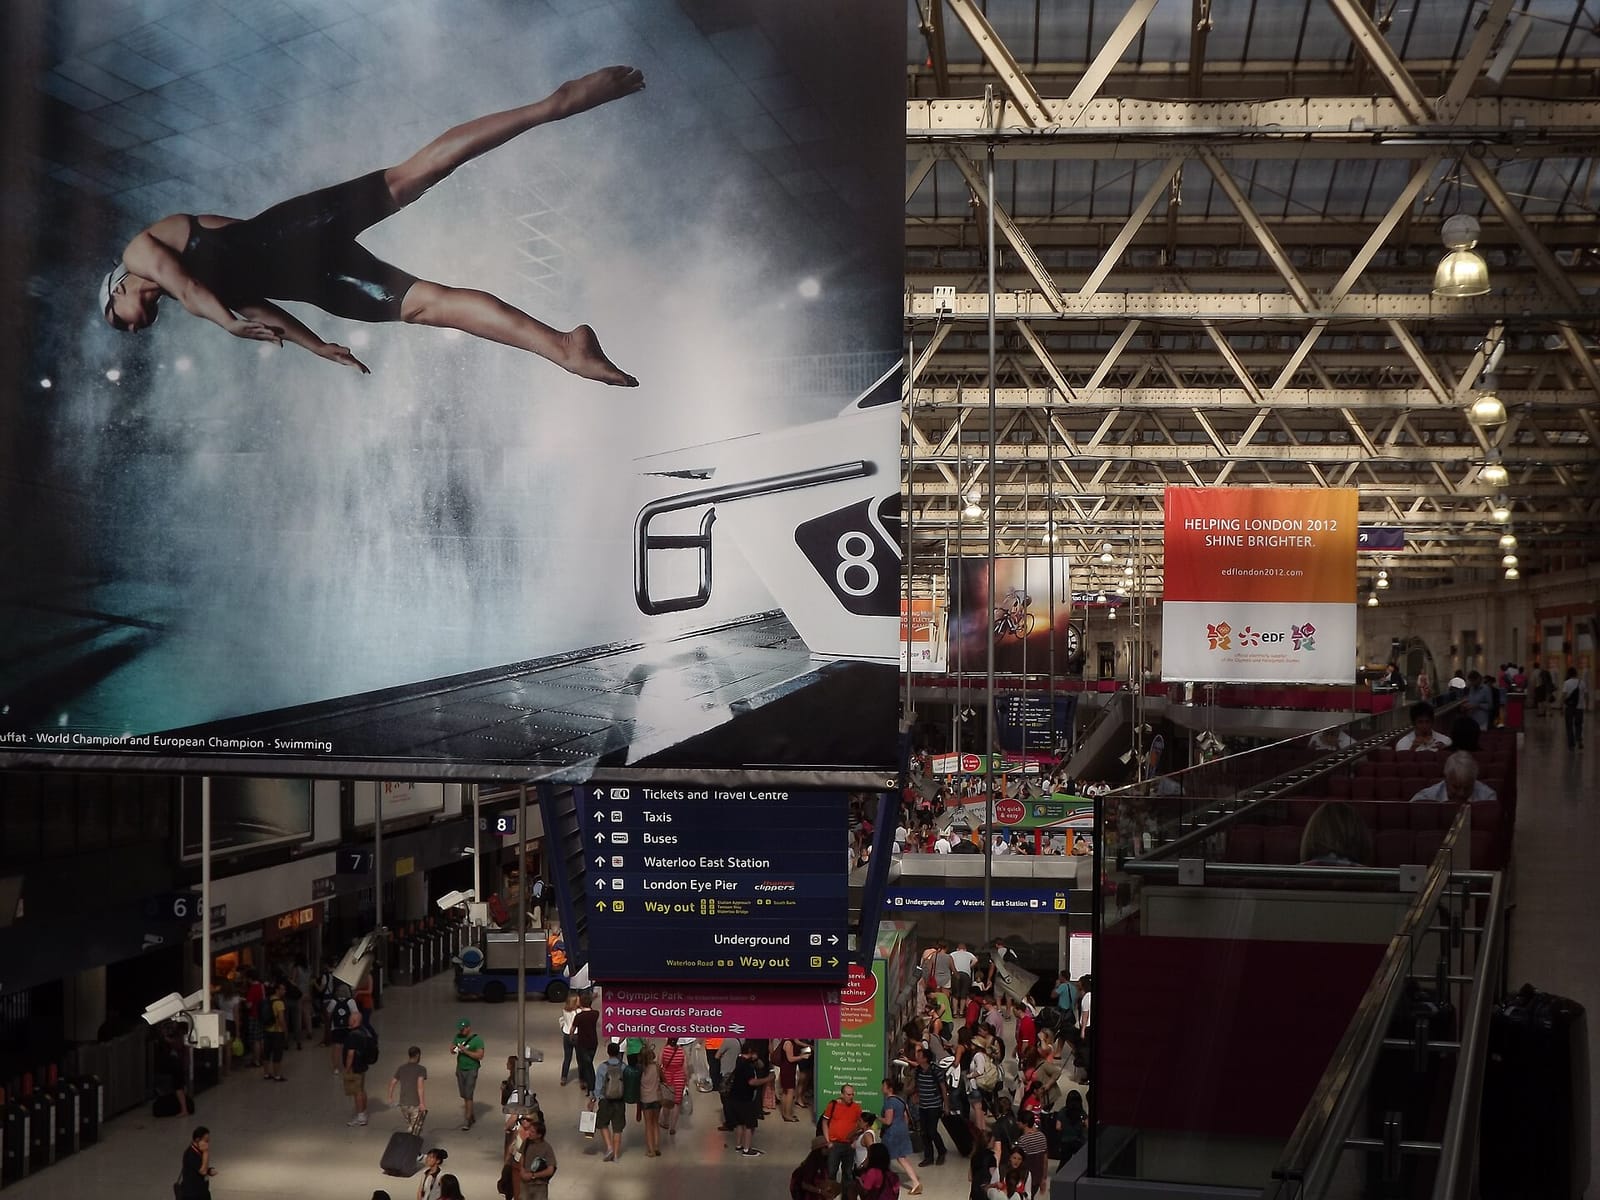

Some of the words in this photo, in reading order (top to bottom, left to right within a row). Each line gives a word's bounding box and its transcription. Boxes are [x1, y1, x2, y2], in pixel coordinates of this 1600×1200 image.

[1184, 518, 1240, 531] HELPING
[1244, 519, 1303, 531] LONDON
[1306, 519, 1337, 532] 2012
[1204, 534, 1244, 547] SHINE
[1248, 535, 1316, 547] BRIGHTER.
[836, 531, 879, 597] 8
[1221, 567, 1304, 577] edflondon2012.com
[36, 733, 70, 744] World
[72, 734, 127, 747] Champion
[129, 735, 150, 746] and
[153, 736, 205, 750] European
[208, 737, 264, 750] Champion
[274, 738, 332, 753] Swimming
[642, 788, 684, 800] Tickets
[687, 790, 709, 800] and
[642, 811, 672, 823] Taxis
[496, 818, 507, 832] 8
[643, 832, 678, 844] Buses
[350, 854, 361, 871] 7
[644, 856, 697, 868] Waterloo
[700, 856, 724, 868] East
[727, 856, 770, 868] Station
[643, 879, 687, 890] London
[690, 879, 712, 893] Eye
[714, 880, 738, 890] Pier
[174, 898, 187, 918] 6
[644, 901, 671, 914] Way
[674, 902, 696, 912] out
[905, 898, 945, 908] Underground
[714, 934, 790, 948] Underground
[739, 956, 766, 969] Way
[768, 957, 790, 968] out
[616, 990, 660, 1002] Olympic
[662, 990, 684, 1000] Park
[616, 1006, 648, 1017] Horse
[650, 1006, 686, 1017] Guards
[688, 1007, 723, 1017] Parade
[616, 1022, 656, 1034] Charing
[658, 1023, 687, 1034] Cross
[689, 1023, 726, 1034] Station
